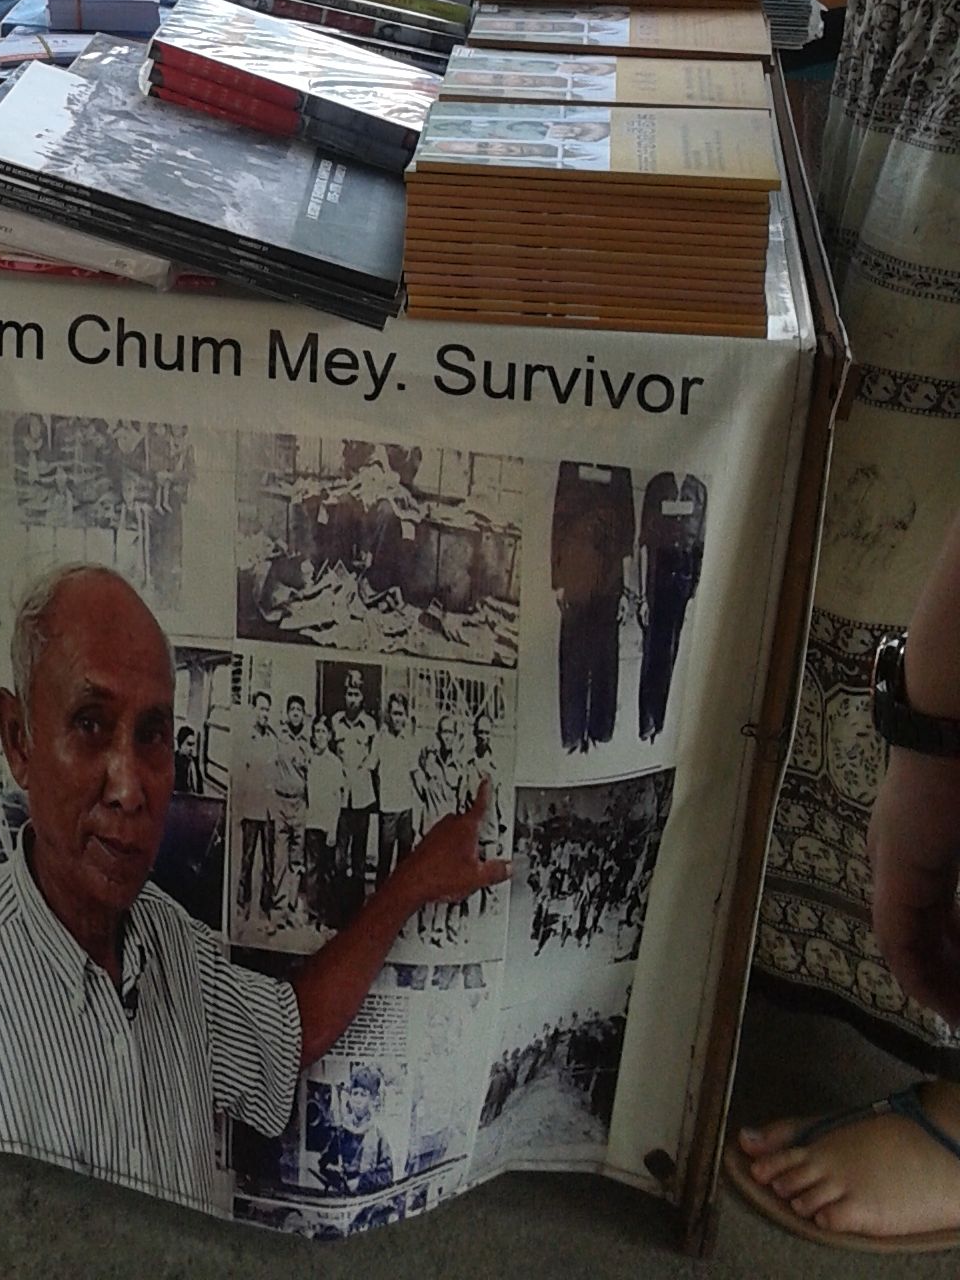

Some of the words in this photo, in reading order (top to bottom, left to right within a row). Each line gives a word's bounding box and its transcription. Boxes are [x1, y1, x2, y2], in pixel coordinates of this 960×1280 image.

[68, 314, 241, 376] Chum
[267, 328, 406, 401] Mey.
[433, 343, 705, 415] Survivor
